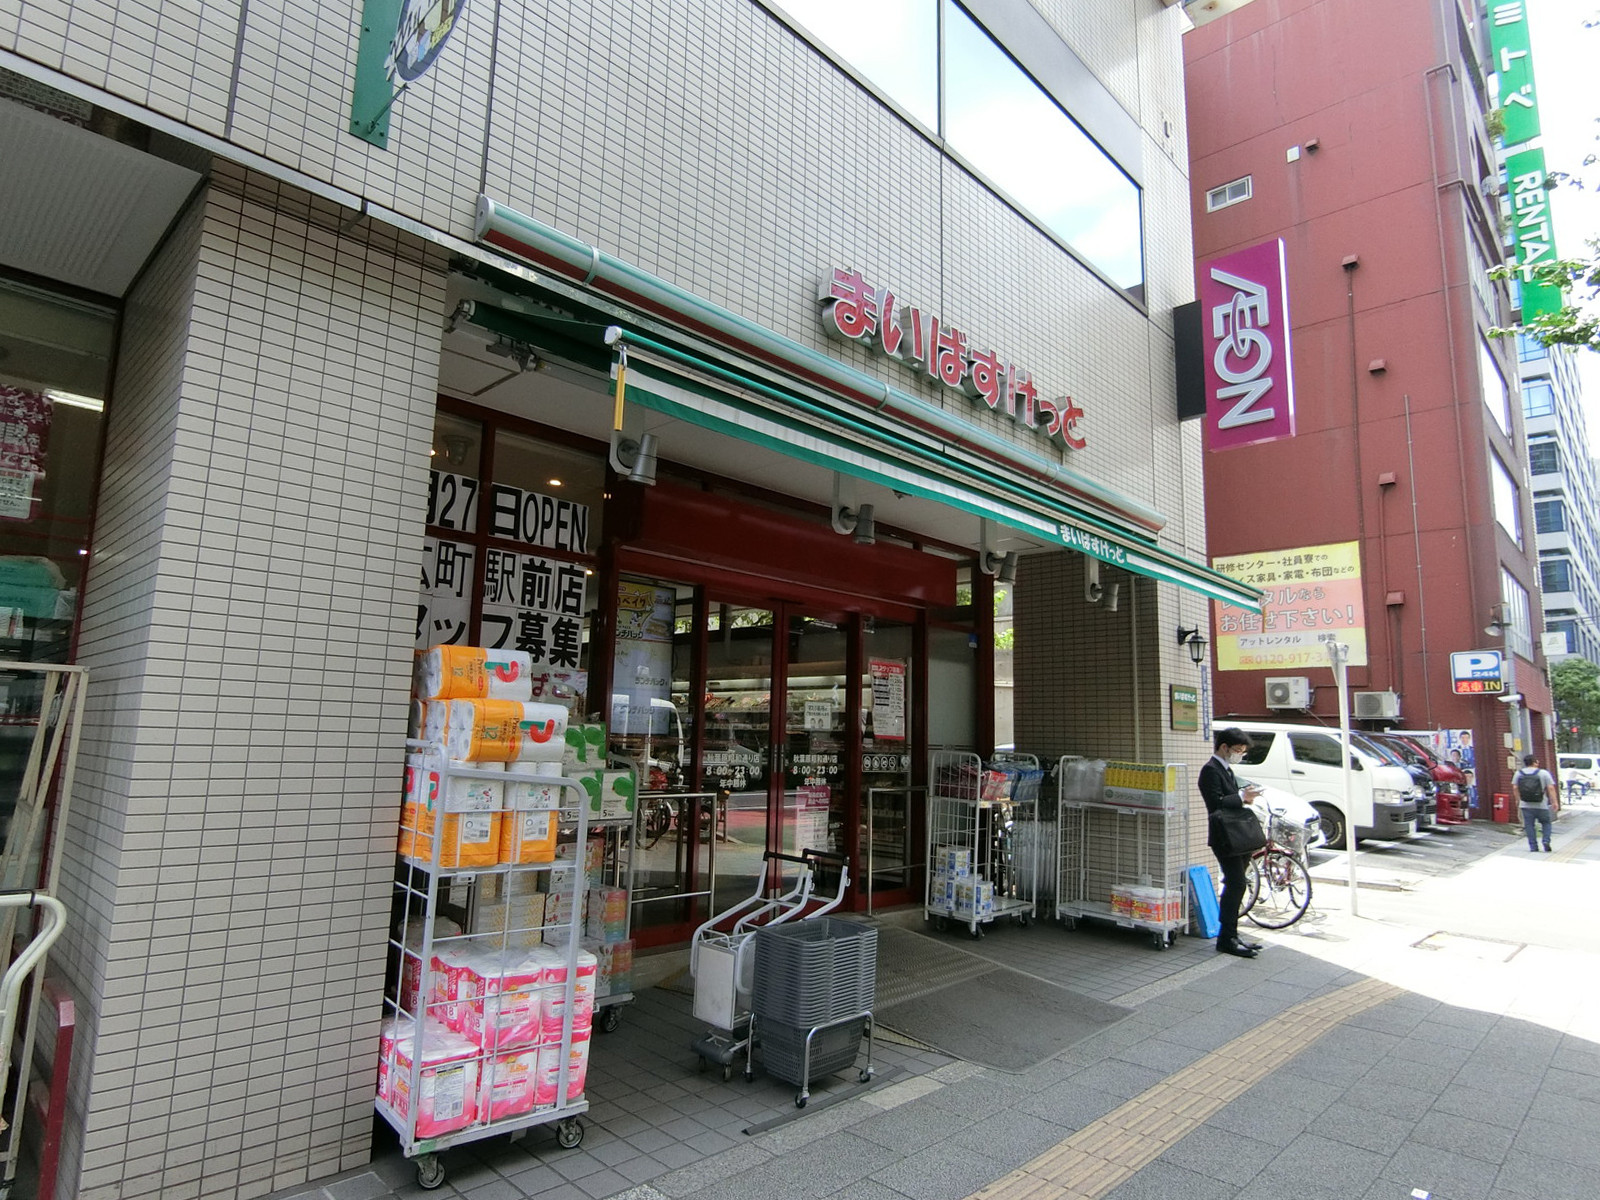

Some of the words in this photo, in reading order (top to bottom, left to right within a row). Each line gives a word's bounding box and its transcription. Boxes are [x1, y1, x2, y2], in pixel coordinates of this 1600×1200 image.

[822, 265, 1087, 450] まいばすけっと
[1210, 267, 1275, 429] AEON
[1059, 525, 1126, 564] まいばすけっと
[1240, 633, 1302, 647] アットレンタル
[1453, 653, 1500, 679] P
[1484, 681, 1500, 691] IN
